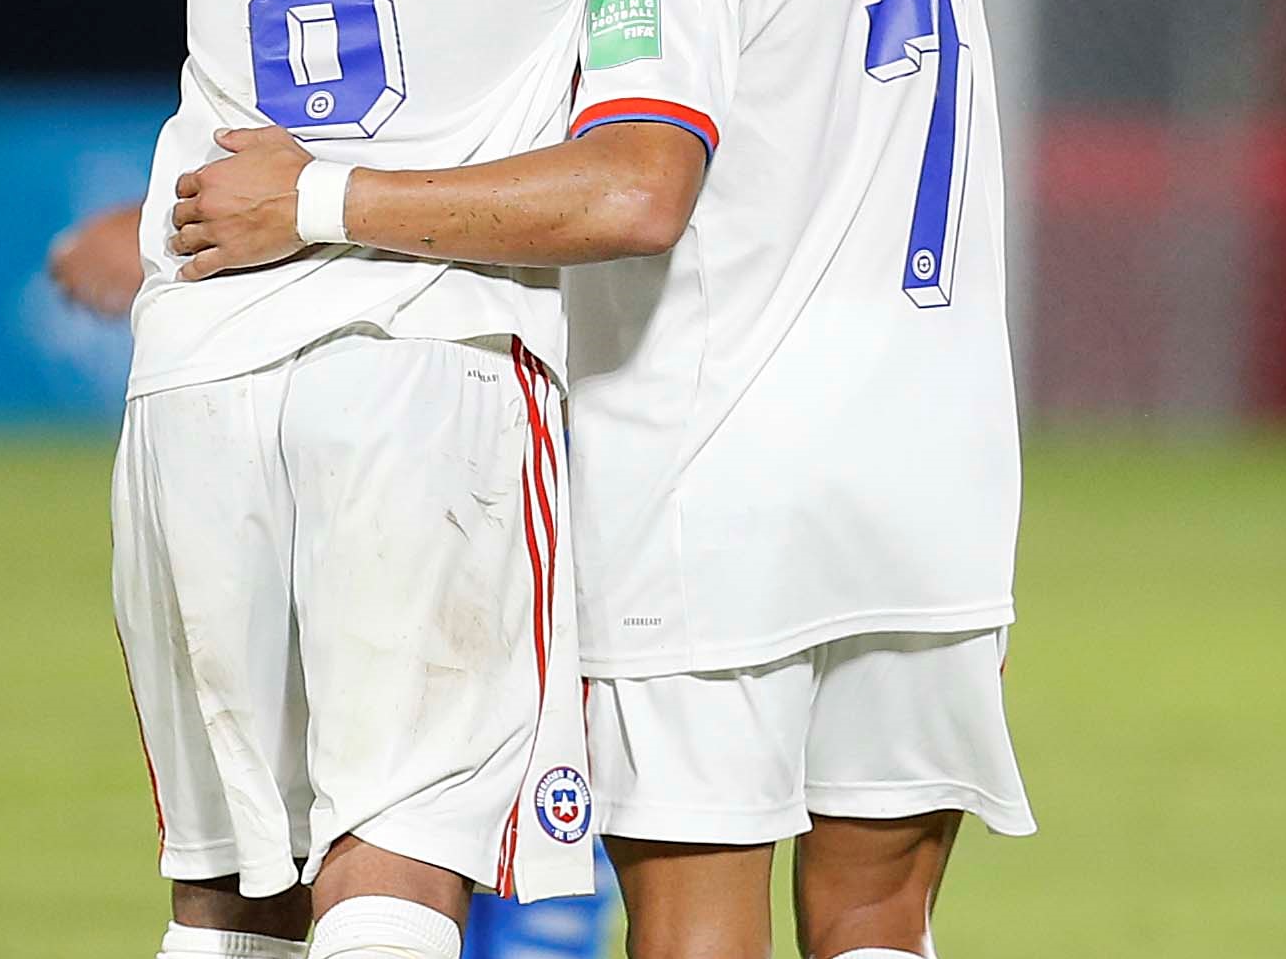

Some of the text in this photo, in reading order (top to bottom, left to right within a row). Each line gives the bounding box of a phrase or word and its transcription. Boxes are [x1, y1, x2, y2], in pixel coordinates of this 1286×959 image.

[591, 0, 655, 21] LIVING
[592, 7, 655, 33] FOOTBALL
[624, 25, 655, 40] FIFA
